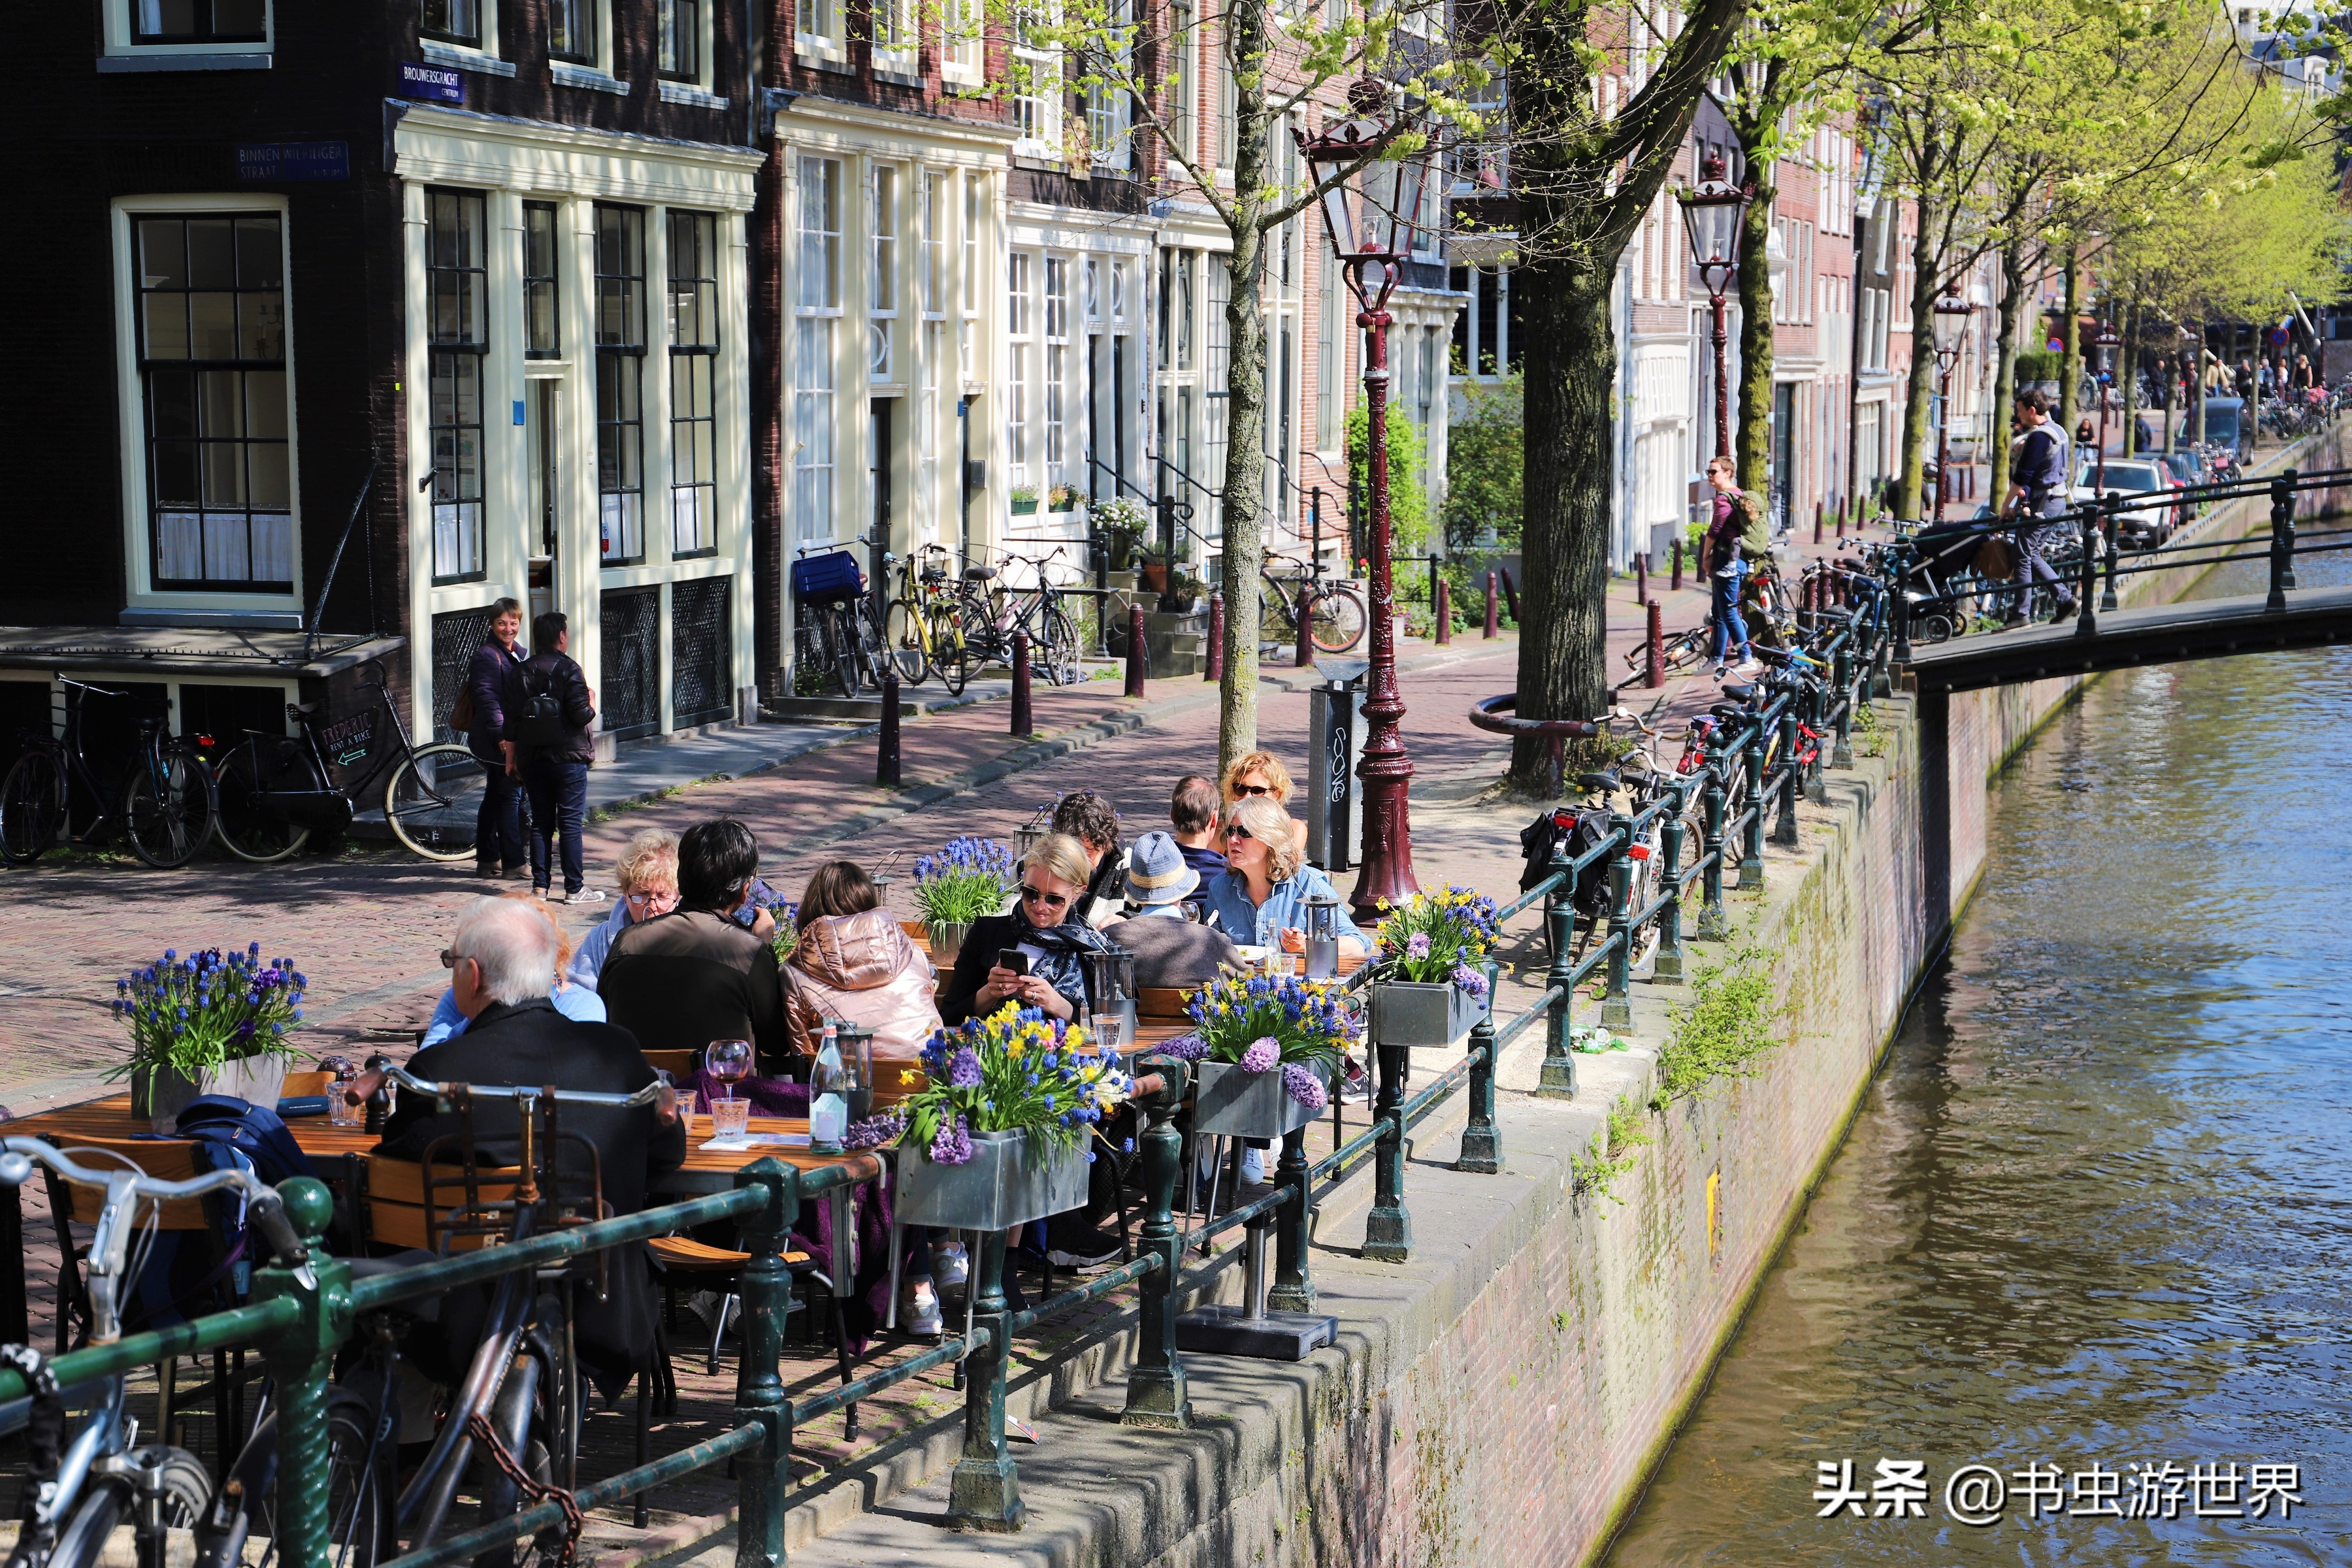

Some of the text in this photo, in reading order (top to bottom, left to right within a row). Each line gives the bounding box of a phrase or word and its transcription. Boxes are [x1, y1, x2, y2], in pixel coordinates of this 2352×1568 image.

[404, 66, 458, 87] BROUWERSGRACHT
[441, 88, 458, 98] CENTRUM
[240, 148, 280, 162] BINNEN
[241, 166, 277, 179] STRAAT
[330, 741, 344, 752] RENT
[354, 730, 371, 743] BIKE
